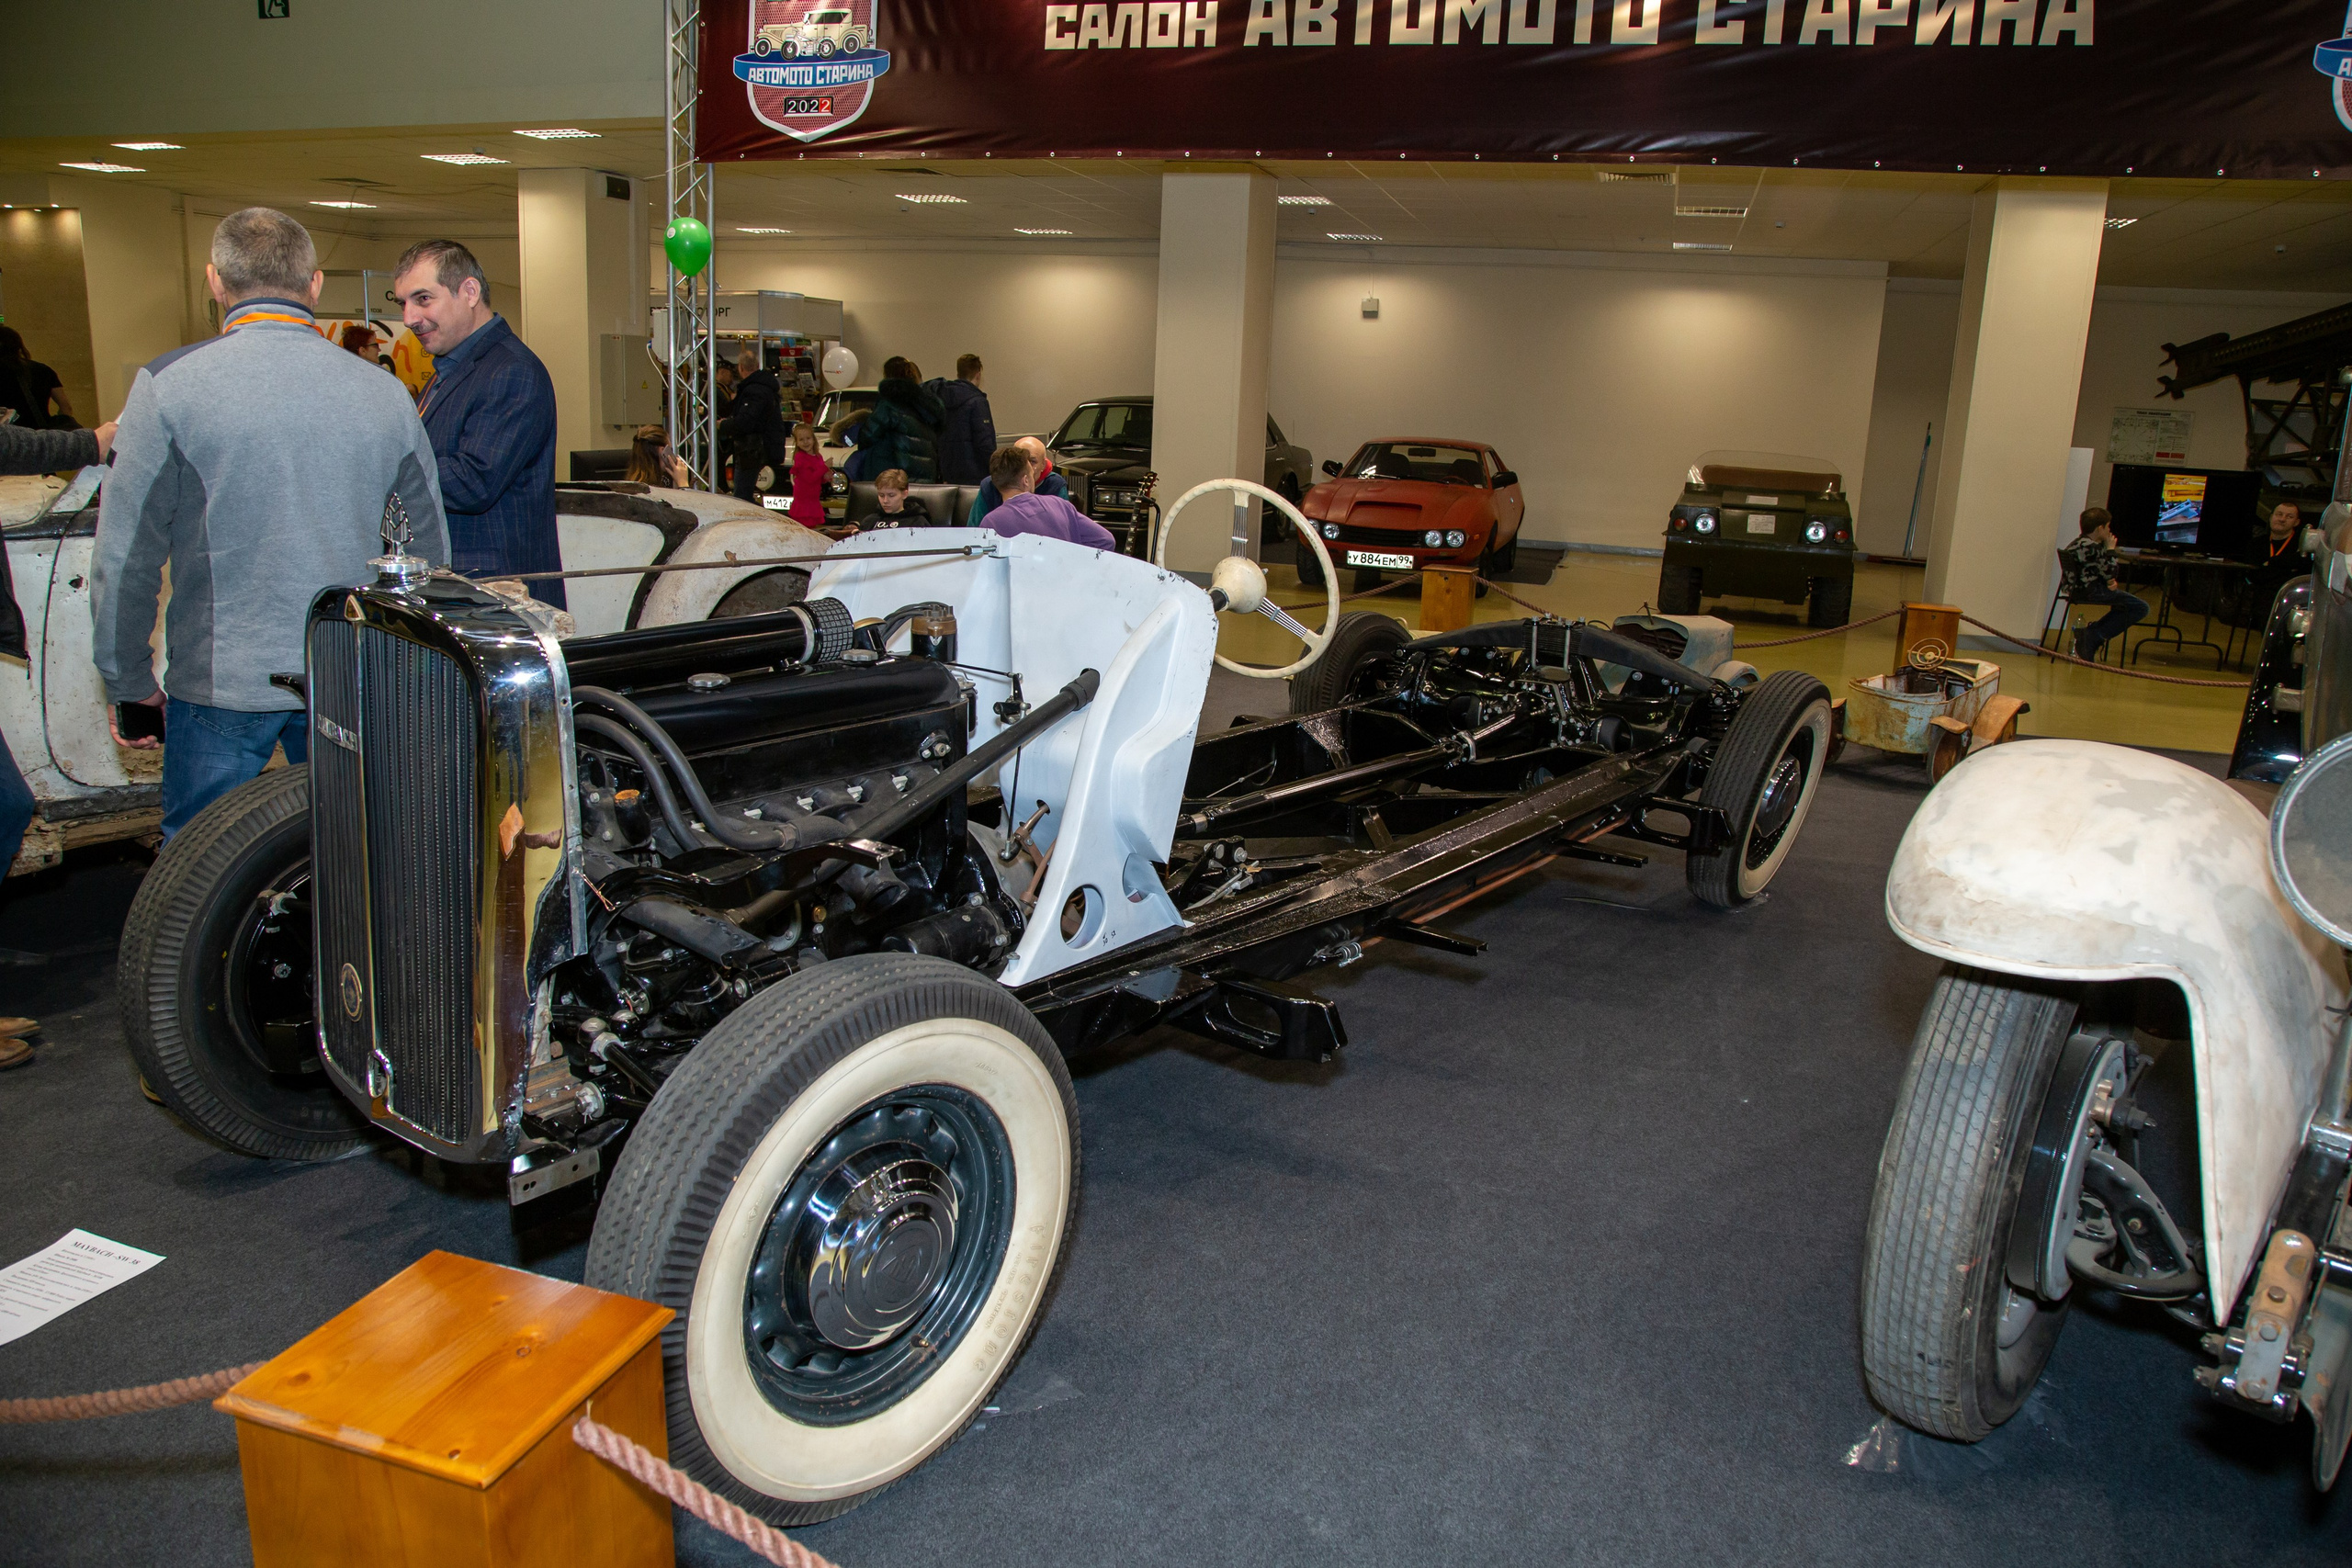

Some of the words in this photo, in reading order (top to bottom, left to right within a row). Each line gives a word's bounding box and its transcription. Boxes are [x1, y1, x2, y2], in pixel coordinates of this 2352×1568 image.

[1045, 1, 1218, 50] САЛОН
[1243, 0, 1658, 46] АВТОМОТО
[1695, 0, 2095, 46] СТАРИНА
[748, 66, 813, 85] АВТОМОТО
[816, 63, 874, 85] СТАРИНА
[787, 99, 831, 113] 2022
[766, 499, 792, 508] М412
[1398, 555, 1409, 564] 99
[71, 1241, 114, 1258] MAYBACH
